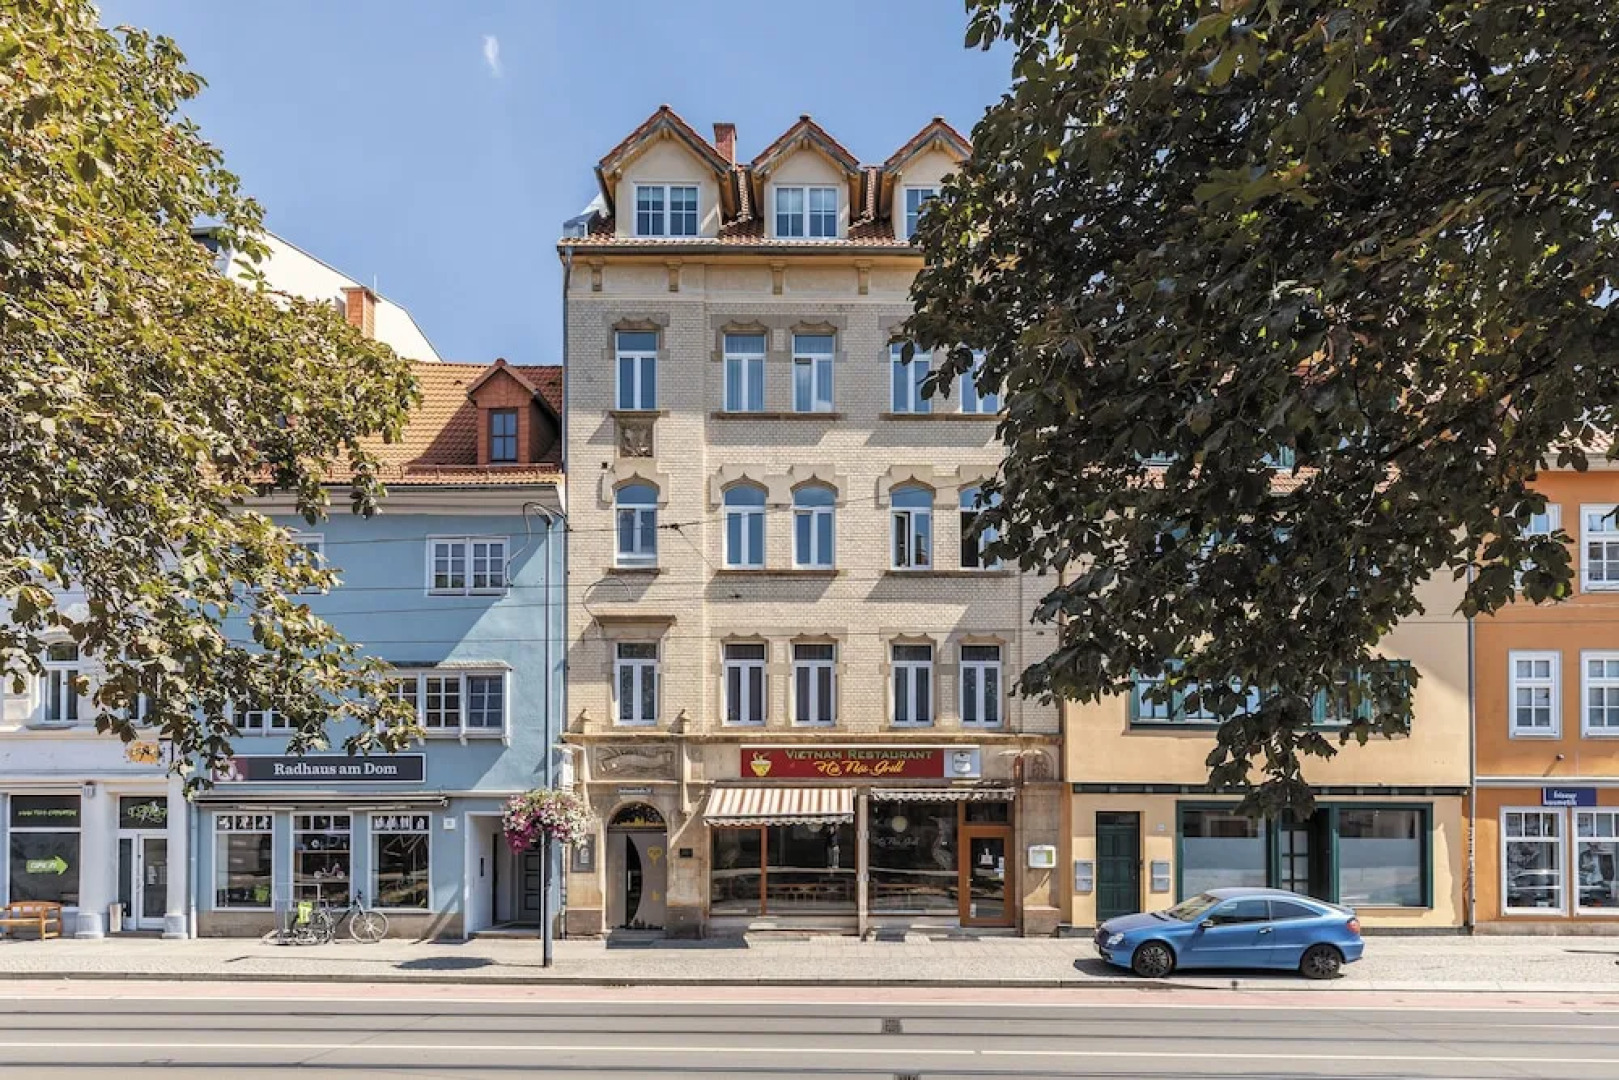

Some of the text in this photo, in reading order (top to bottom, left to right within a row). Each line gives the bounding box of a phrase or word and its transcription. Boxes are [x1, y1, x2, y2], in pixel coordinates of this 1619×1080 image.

[785, 749, 933, 760] VIETNAM RESTAURANT
[274, 762, 398, 775] Radhaus am Dom
